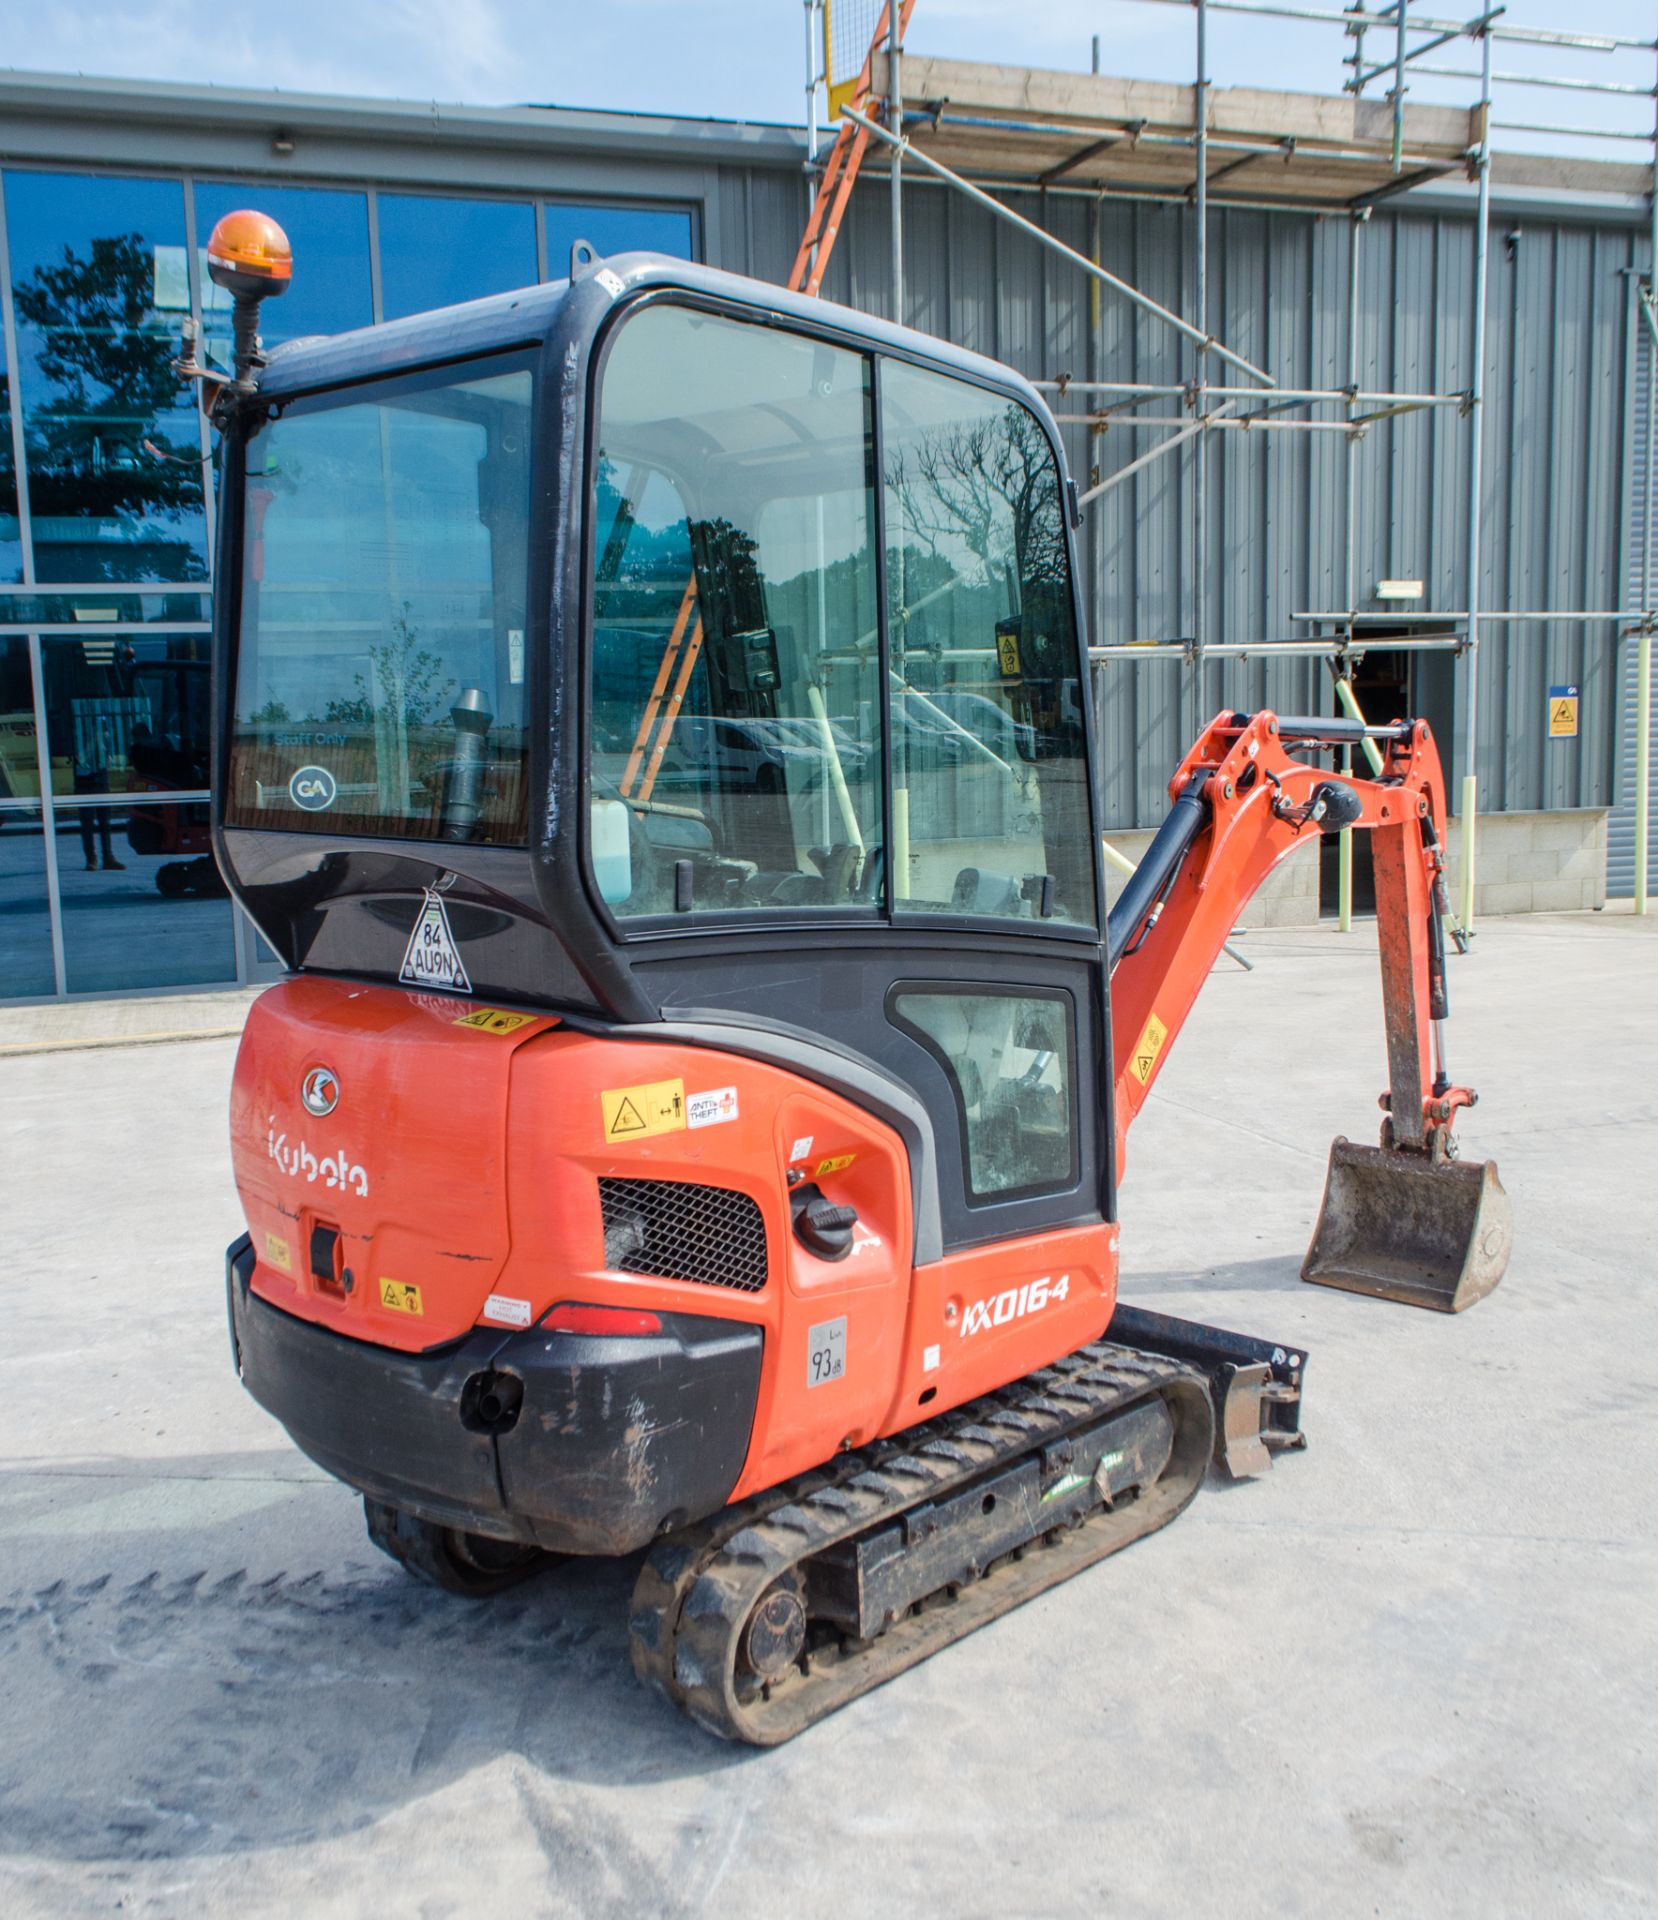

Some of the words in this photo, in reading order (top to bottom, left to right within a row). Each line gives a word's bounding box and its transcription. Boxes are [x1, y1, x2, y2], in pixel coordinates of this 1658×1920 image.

[315, 732, 347, 747] Only
[424, 923, 440, 948] 84
[415, 949, 453, 977] AU9N
[690, 1108, 718, 1121] THEFT
[268, 1114, 369, 1197] Kubota
[812, 1348, 831, 1381] 93
[832, 1359, 842, 1375] dB
